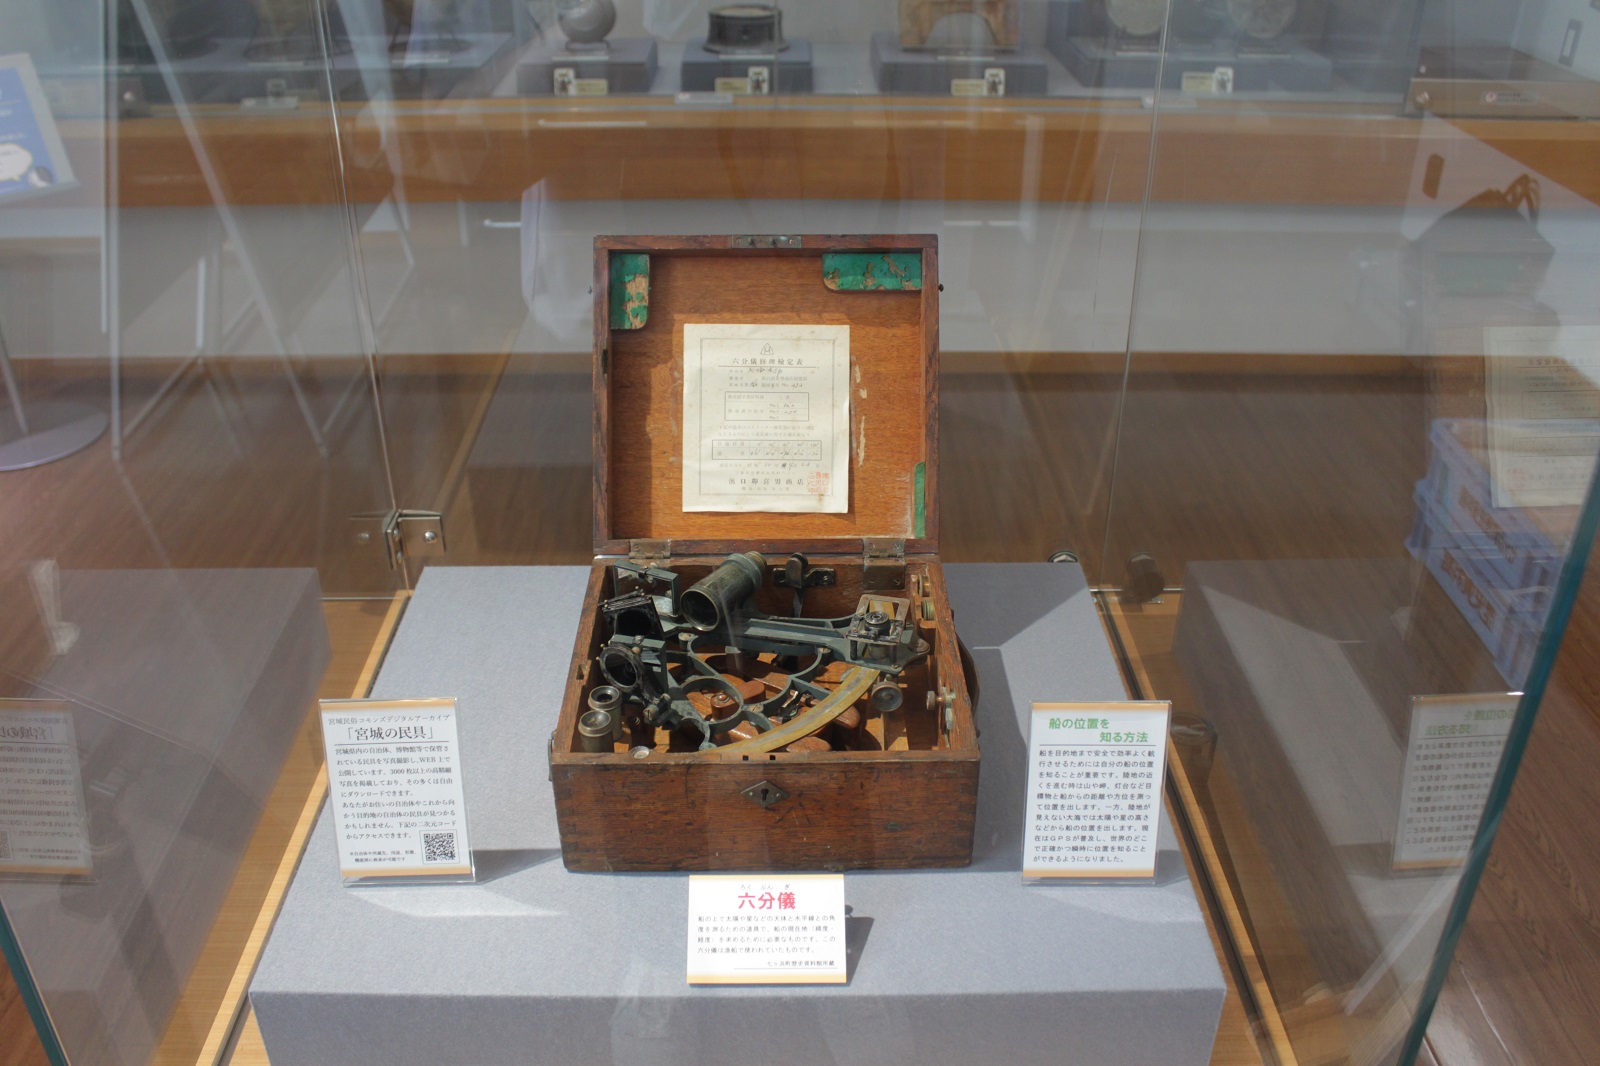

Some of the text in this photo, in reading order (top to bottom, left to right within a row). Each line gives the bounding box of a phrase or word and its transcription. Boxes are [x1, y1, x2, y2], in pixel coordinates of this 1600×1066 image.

[328, 714, 450, 726] 宮城民俗コモンズデジタルアーカイブ
[1048, 717, 1110, 730] 船の位置を
[346, 726, 435, 741] 「宮城の民具」
[1099, 731, 1149, 743] 知る方法
[335, 745, 449, 755] 宮城県内の自治体、博物館等で保管さ
[1039, 749, 1155, 757] 船を目的地まで安全で効率よく航
[1038, 760, 1154, 768] 行させるためには自分の船の位置
[1038, 771, 1153, 779] を知ることが重要です。陸地の近
[1038, 782, 1152, 790] くを進む時は山や岬、灯台など目
[340, 790, 414, 798] にダウンロードできます。
[1036, 793, 1151, 801] 標物と船からの距離や方位を測っ
[1036, 803, 1151, 811] て位置を出します。一方、陸地が
[343, 809, 456, 819] かう目的地の自治体の民具が見つかる
[1035, 814, 1150, 822] 見えない大海では太陽や星の高さ
[344, 820, 457, 829] かもしれません。下記の二次元コード
[1035, 824, 1149, 832] などから船の位置を出します。現
[345, 832, 413, 840] からアクセスできます。
[1034, 845, 1147, 853] で正確かつ瞬時に位置を知ること
[1032, 855, 1125, 863] ができるようになりました。
[737, 891, 796, 910] 六分儀
[698, 915, 836, 923] 船の上で太陽や星などの天体と水平線との角
[697, 946, 816, 954] 六分儀は漁船で使われていたものです。
